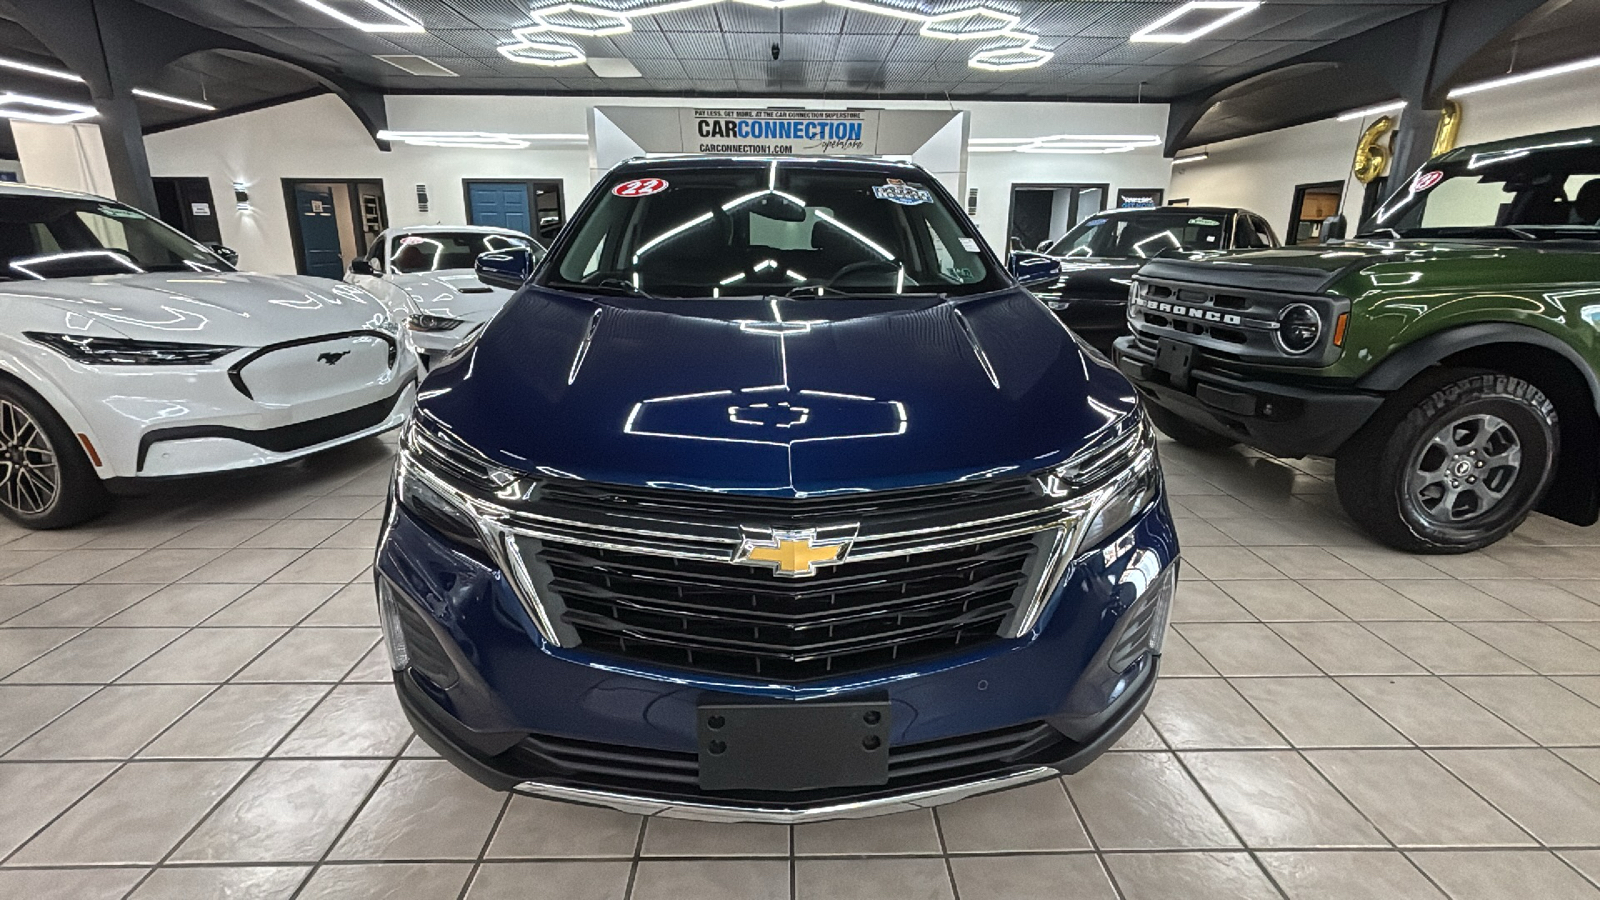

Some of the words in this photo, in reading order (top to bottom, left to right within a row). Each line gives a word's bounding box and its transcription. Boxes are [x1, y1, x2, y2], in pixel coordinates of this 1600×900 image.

[699, 143, 793, 154] CARCONNECTION1.COM
[621, 179, 659, 195] 22
[1147, 300, 1241, 325] BRONCO
